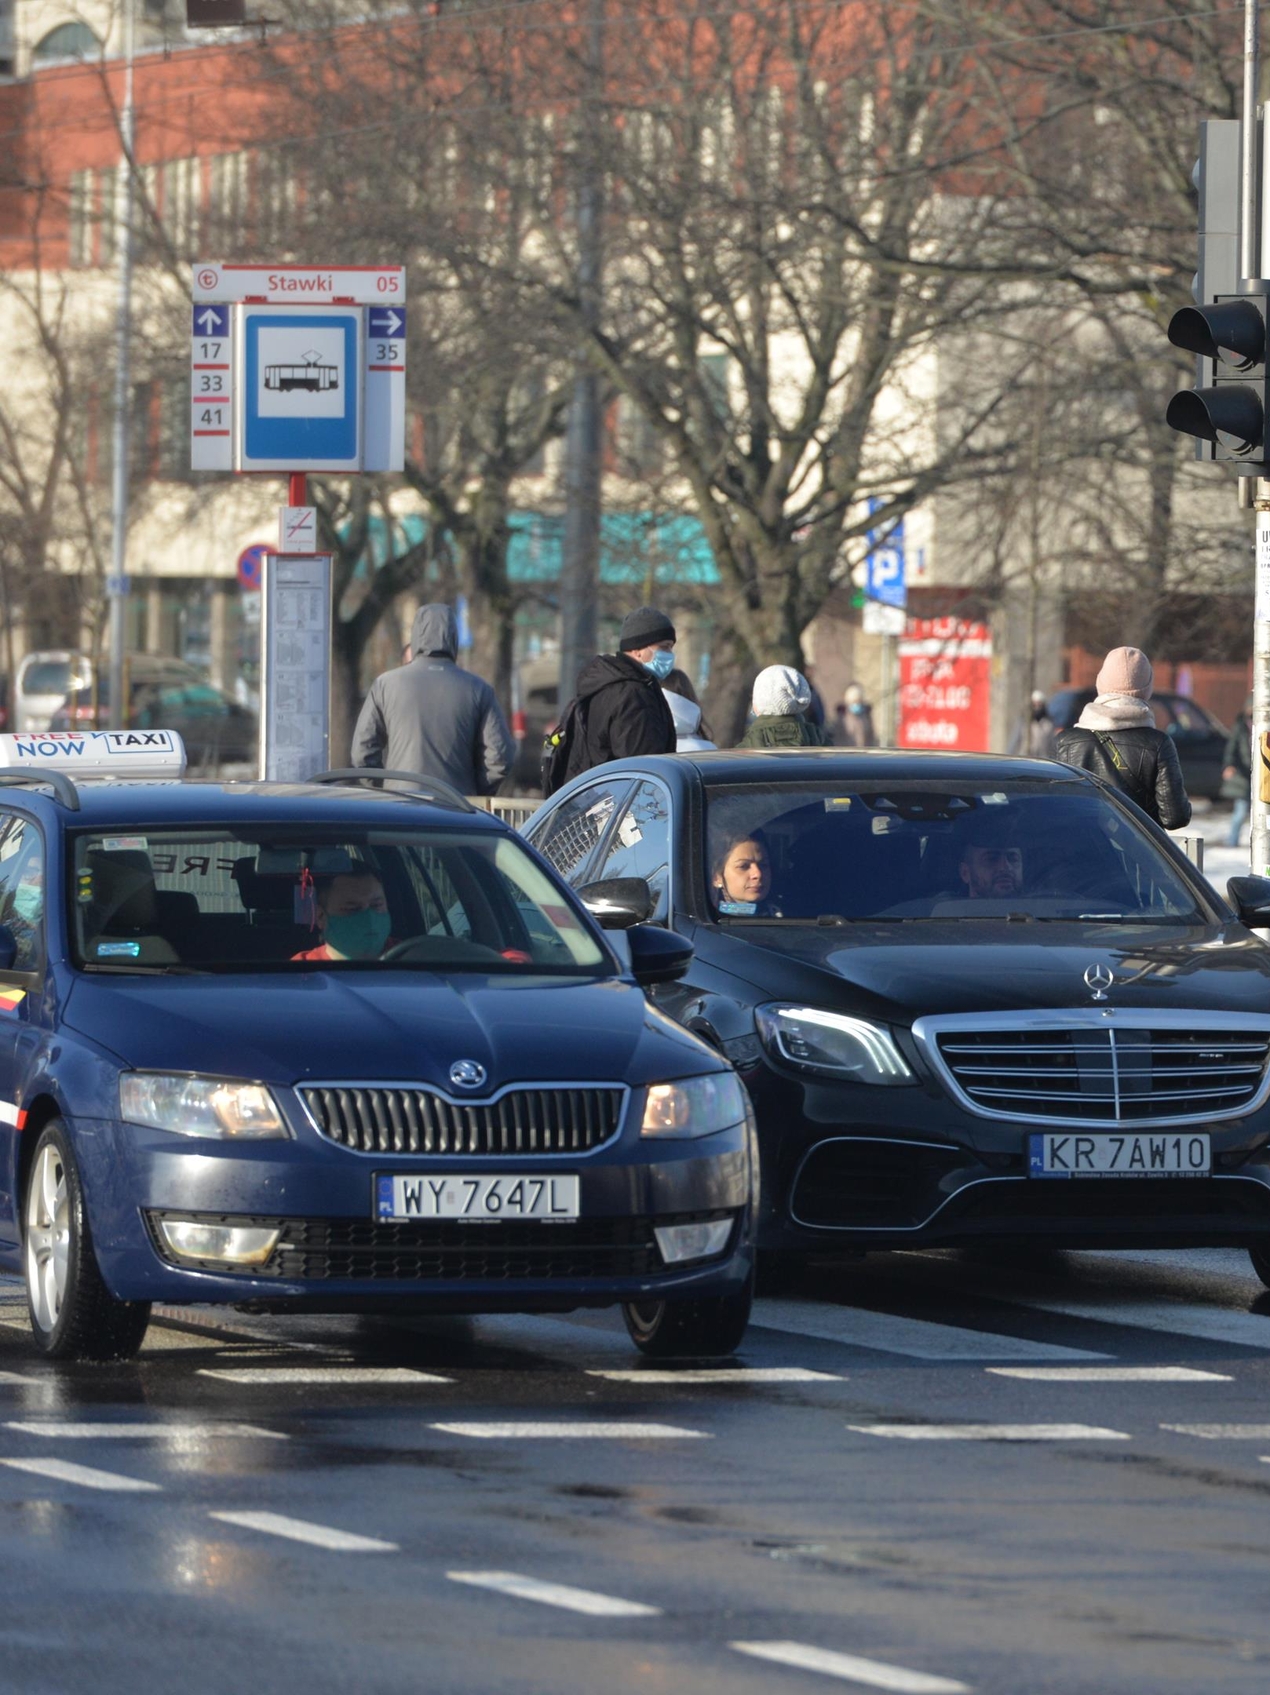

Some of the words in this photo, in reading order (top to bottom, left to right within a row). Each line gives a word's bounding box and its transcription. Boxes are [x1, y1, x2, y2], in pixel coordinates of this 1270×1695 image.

[268, 275, 332, 291] Stawki
[377, 276, 399, 292] 05
[200, 343, 221, 358] 17
[376, 344, 398, 360] 35
[200, 375, 223, 392] 33
[200, 409, 222, 425] 41
[872, 549, 899, 588] P
[109, 733, 167, 745] TAXI
[16, 741, 85, 757] NOW
[1050, 1137, 1096, 1168] KR
[1108, 1137, 1205, 1168] 7AW10
[1031, 1157, 1042, 1166] PL
[402, 1179, 446, 1214] WY
[461, 1179, 568, 1214] 7647L
[379, 1202, 392, 1212] PL
